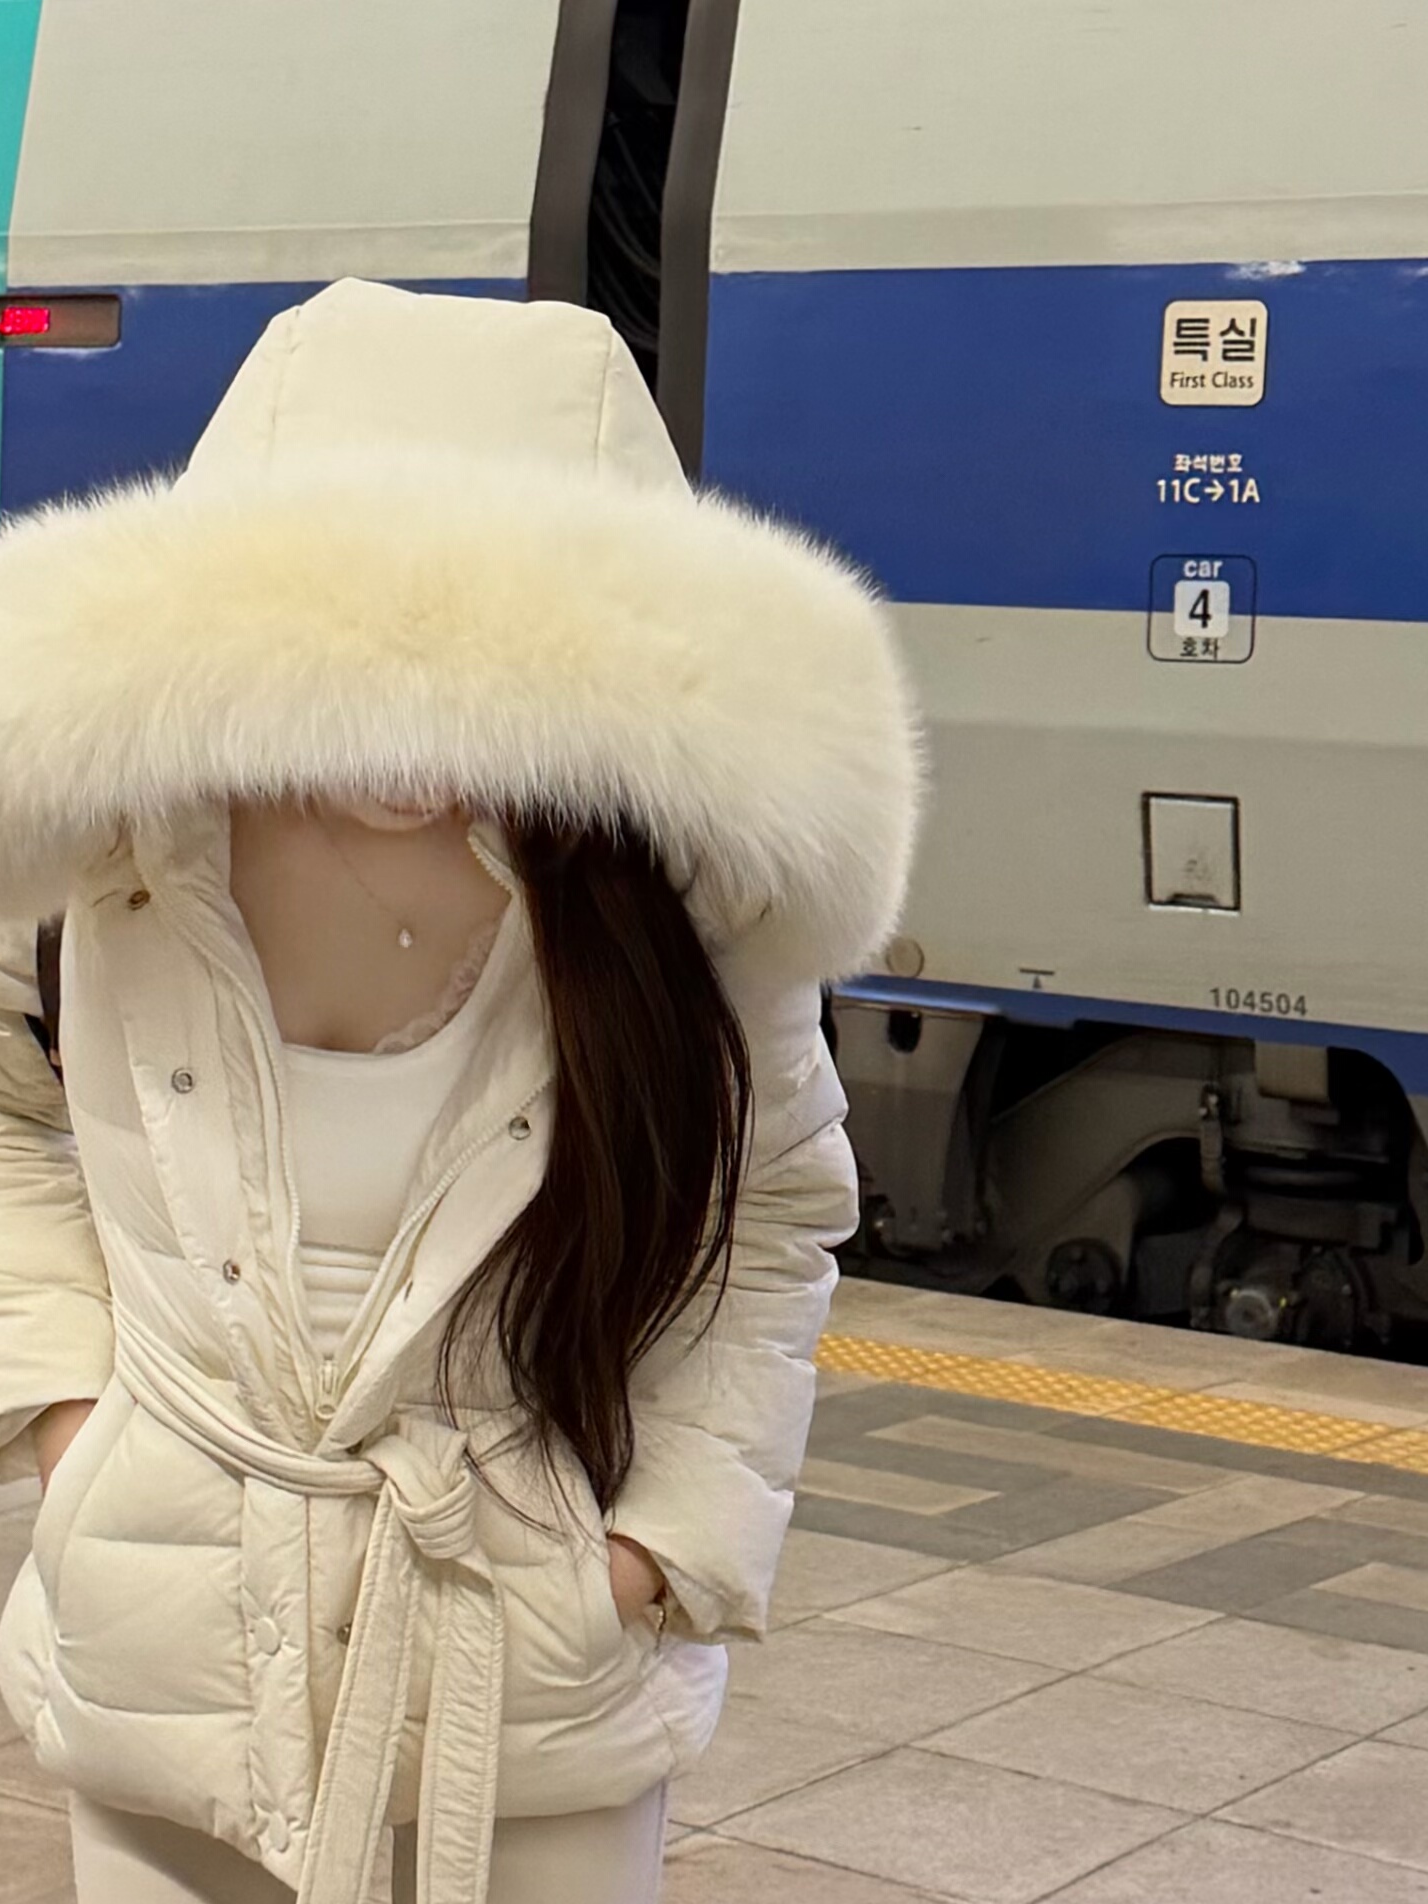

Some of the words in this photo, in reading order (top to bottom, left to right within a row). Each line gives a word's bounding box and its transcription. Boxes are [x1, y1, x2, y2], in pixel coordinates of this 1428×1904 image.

[1172, 316, 1259, 364] 특실
[1169, 371, 1207, 389] First
[1212, 369, 1255, 390] Class
[1174, 453, 1243, 473] 좌석번호
[1183, 559, 1223, 579] car
[1187, 588, 1213, 630] 4
[1180, 638, 1221, 660] 호차
[1208, 987, 1309, 1019] 104504
